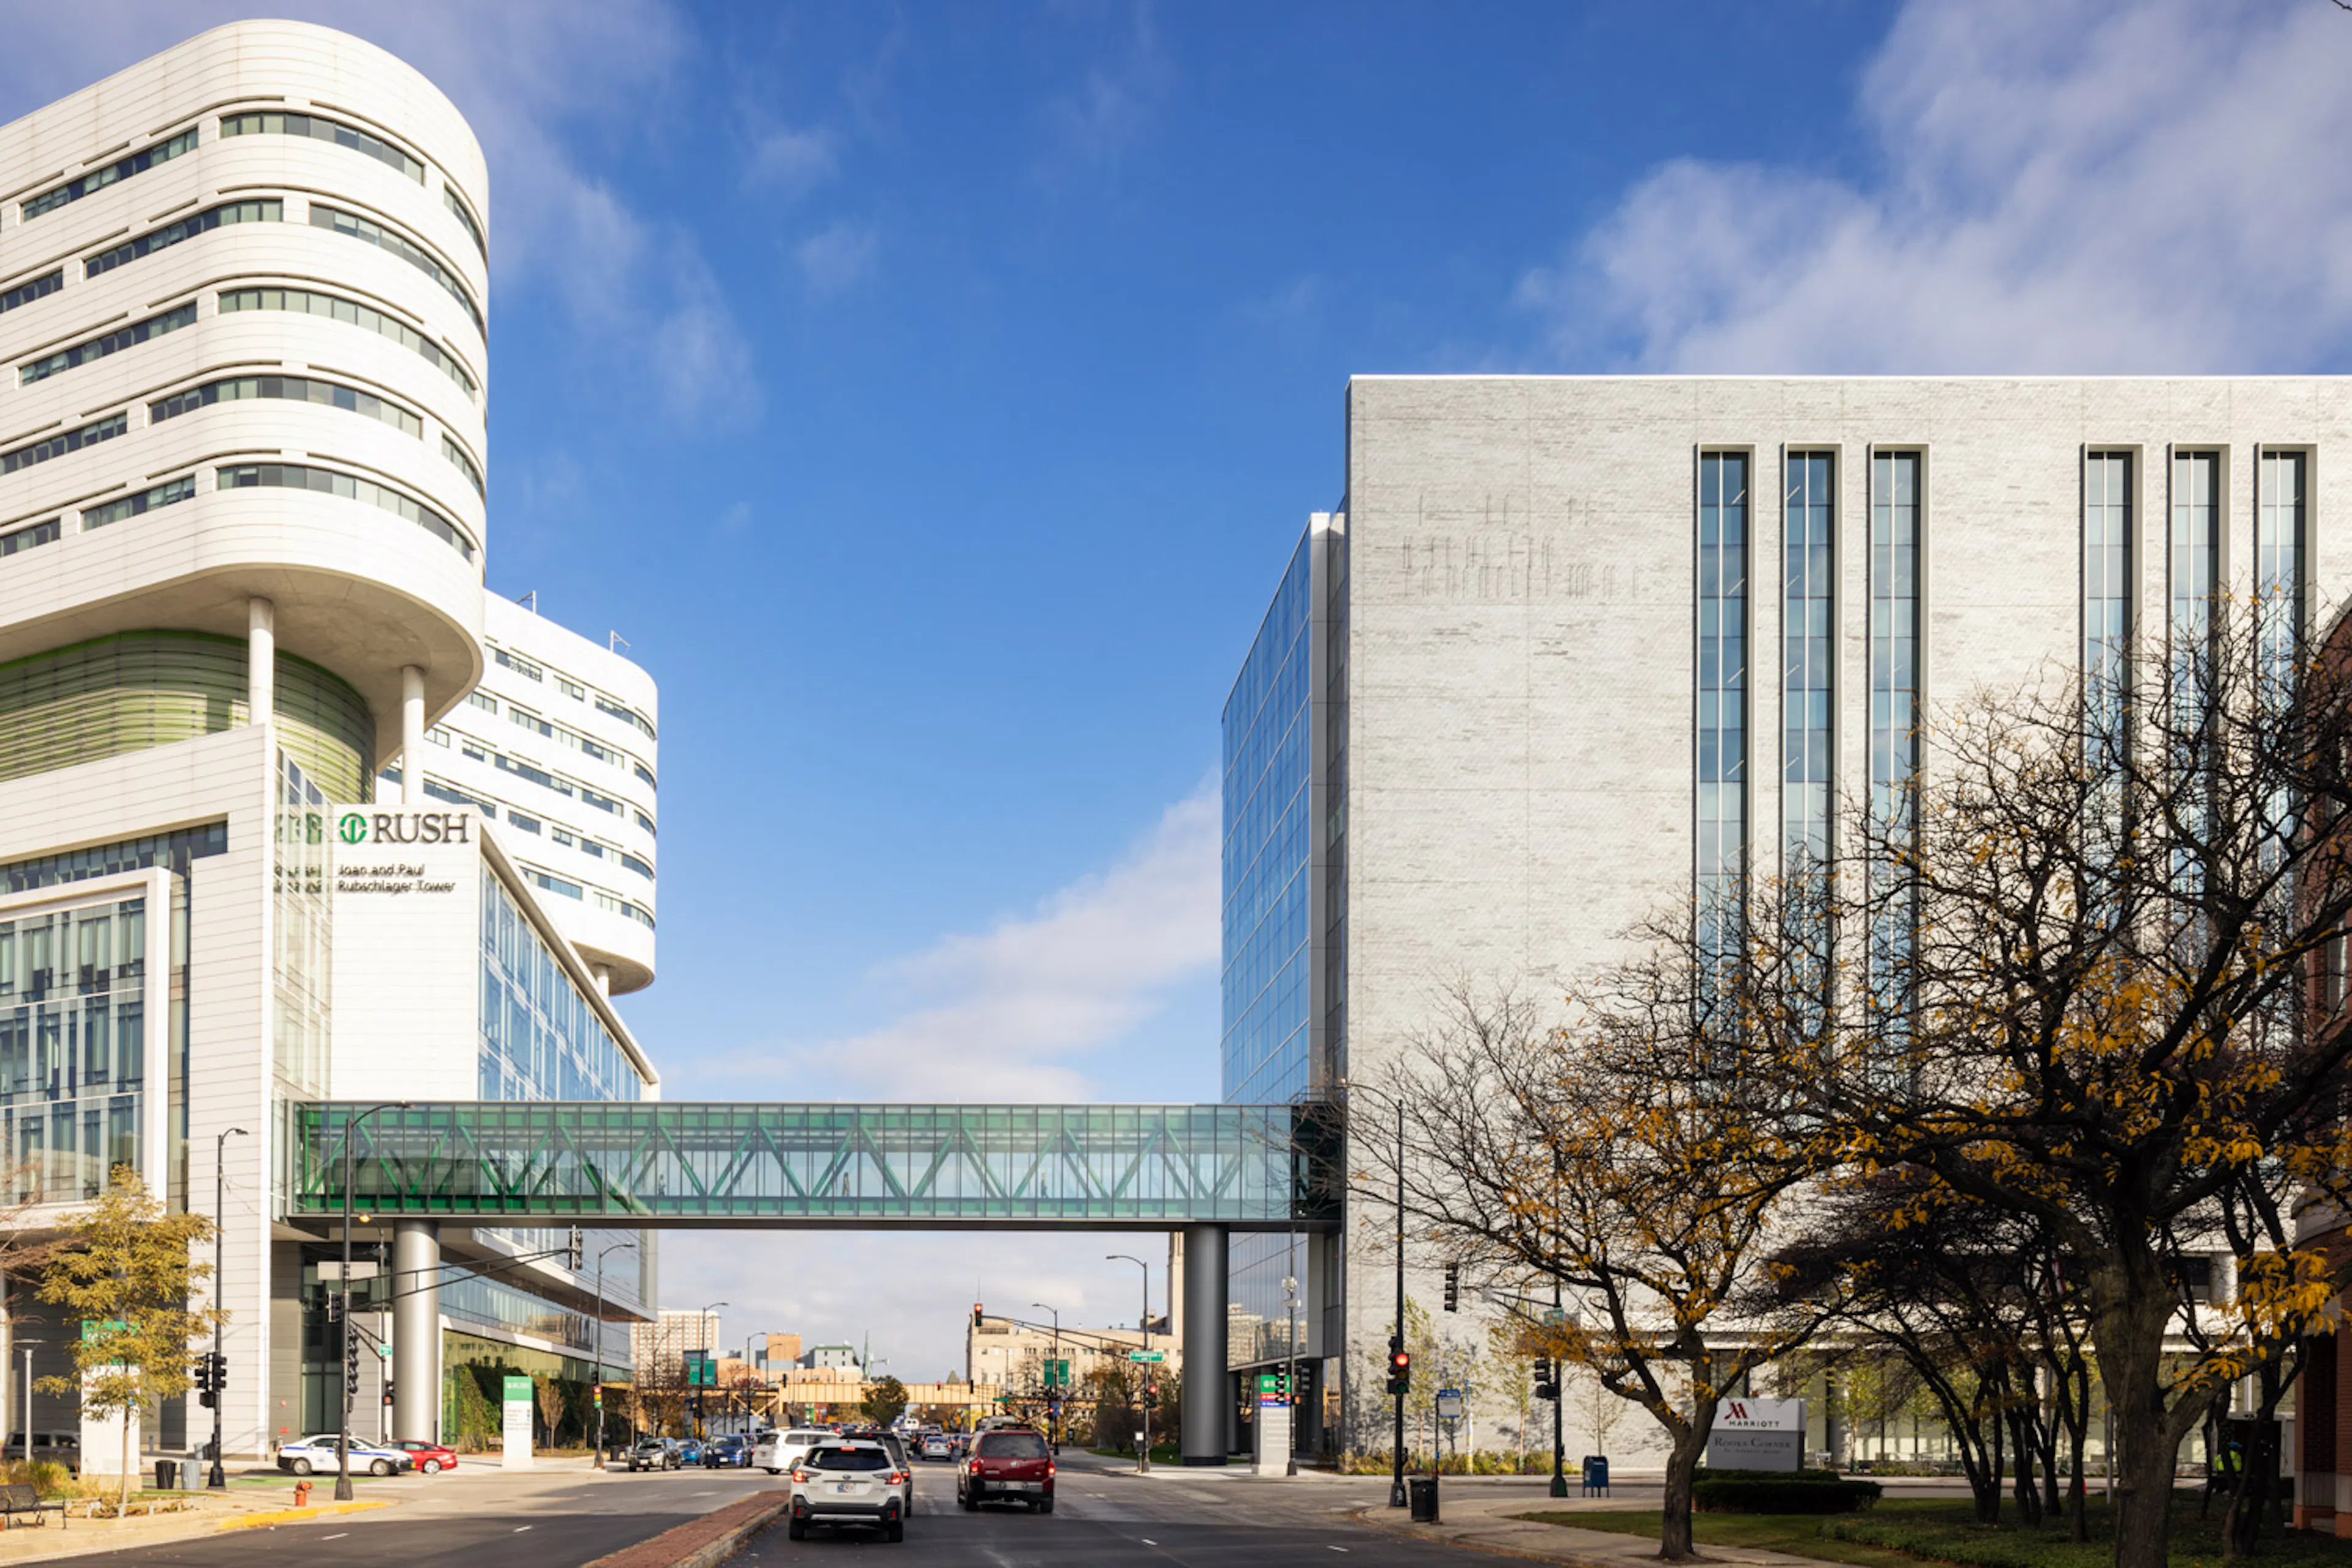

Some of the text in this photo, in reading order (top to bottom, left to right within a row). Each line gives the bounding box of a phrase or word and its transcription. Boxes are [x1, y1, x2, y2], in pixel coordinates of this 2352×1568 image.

[373, 813, 469, 843] RUSH
[338, 864, 425, 876] Joan and Paul
[338, 880, 456, 894] Rubschlager Tower
